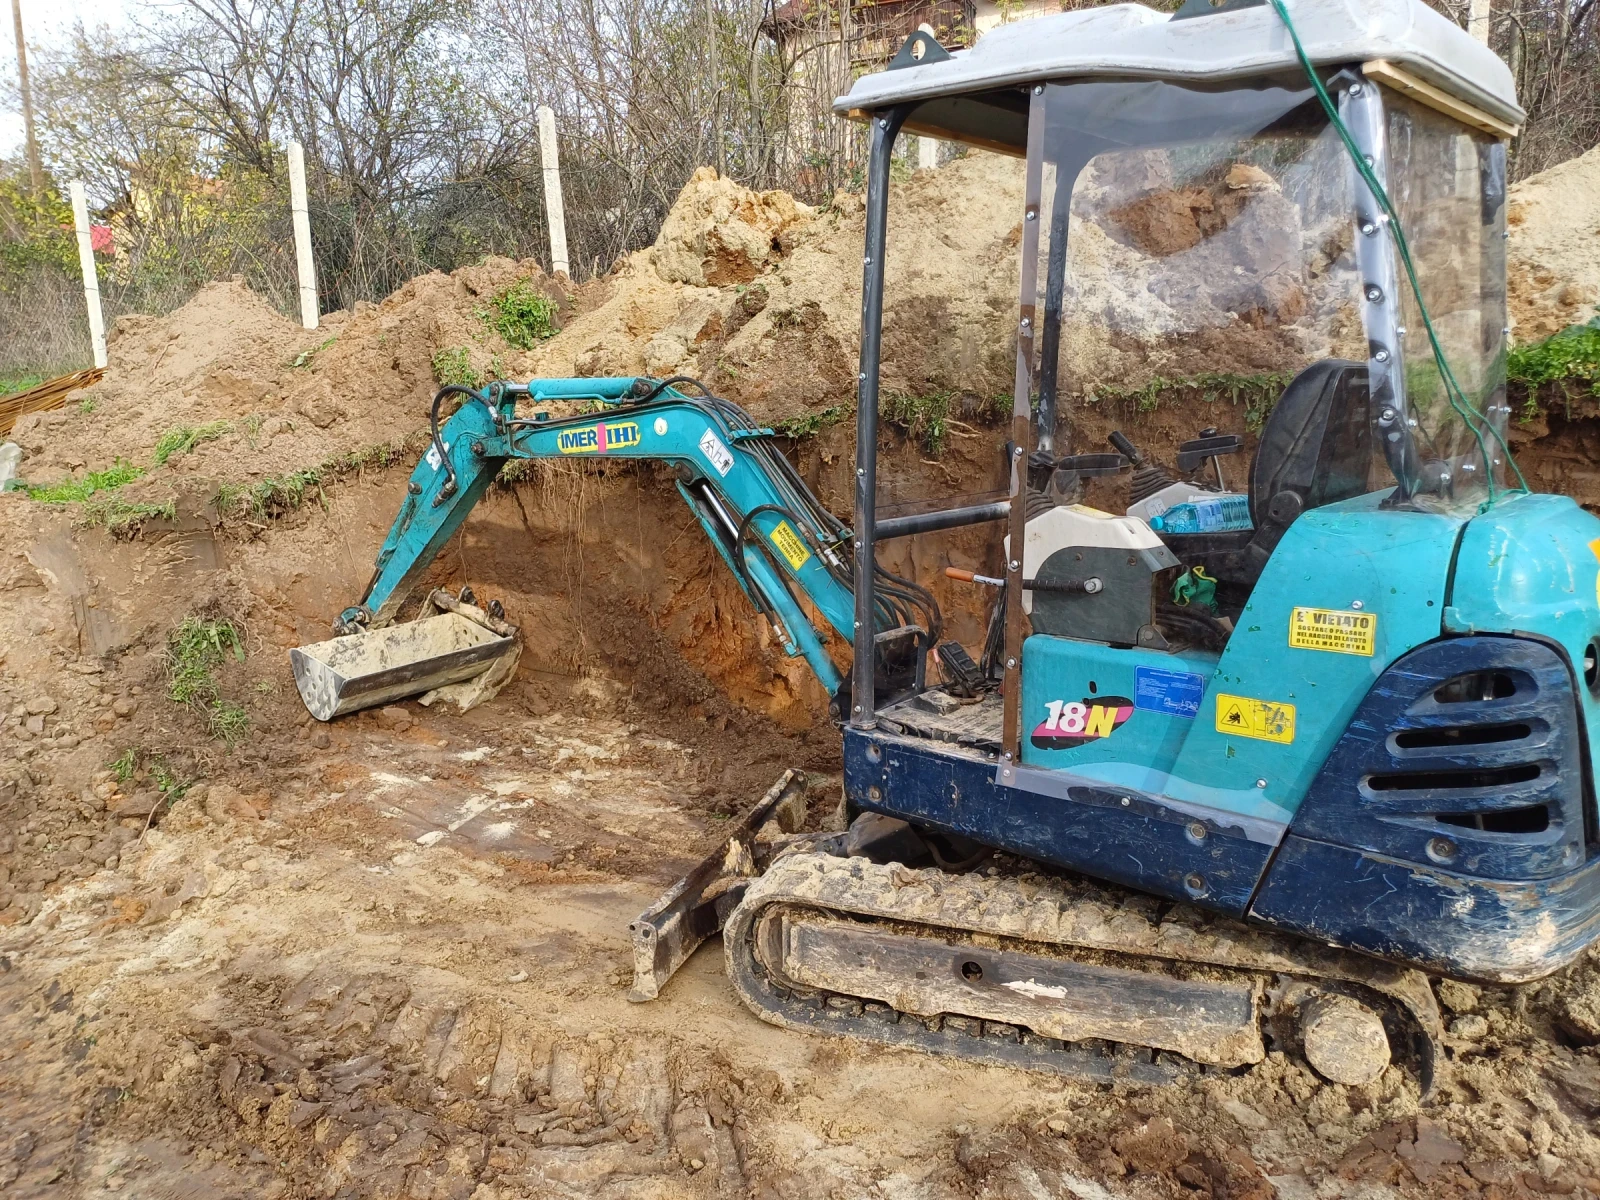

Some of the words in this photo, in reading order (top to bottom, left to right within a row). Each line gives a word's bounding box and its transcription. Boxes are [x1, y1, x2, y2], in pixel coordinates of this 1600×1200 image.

[606, 426, 638, 445] IHI
[777, 529, 803, 562] MOVIMENTO
[779, 540, 794, 560] TERRA
[1313, 613, 1369, 629] VIETATO
[1322, 641, 1366, 651] MACCHINA
[1044, 699, 1119, 738] 18N
